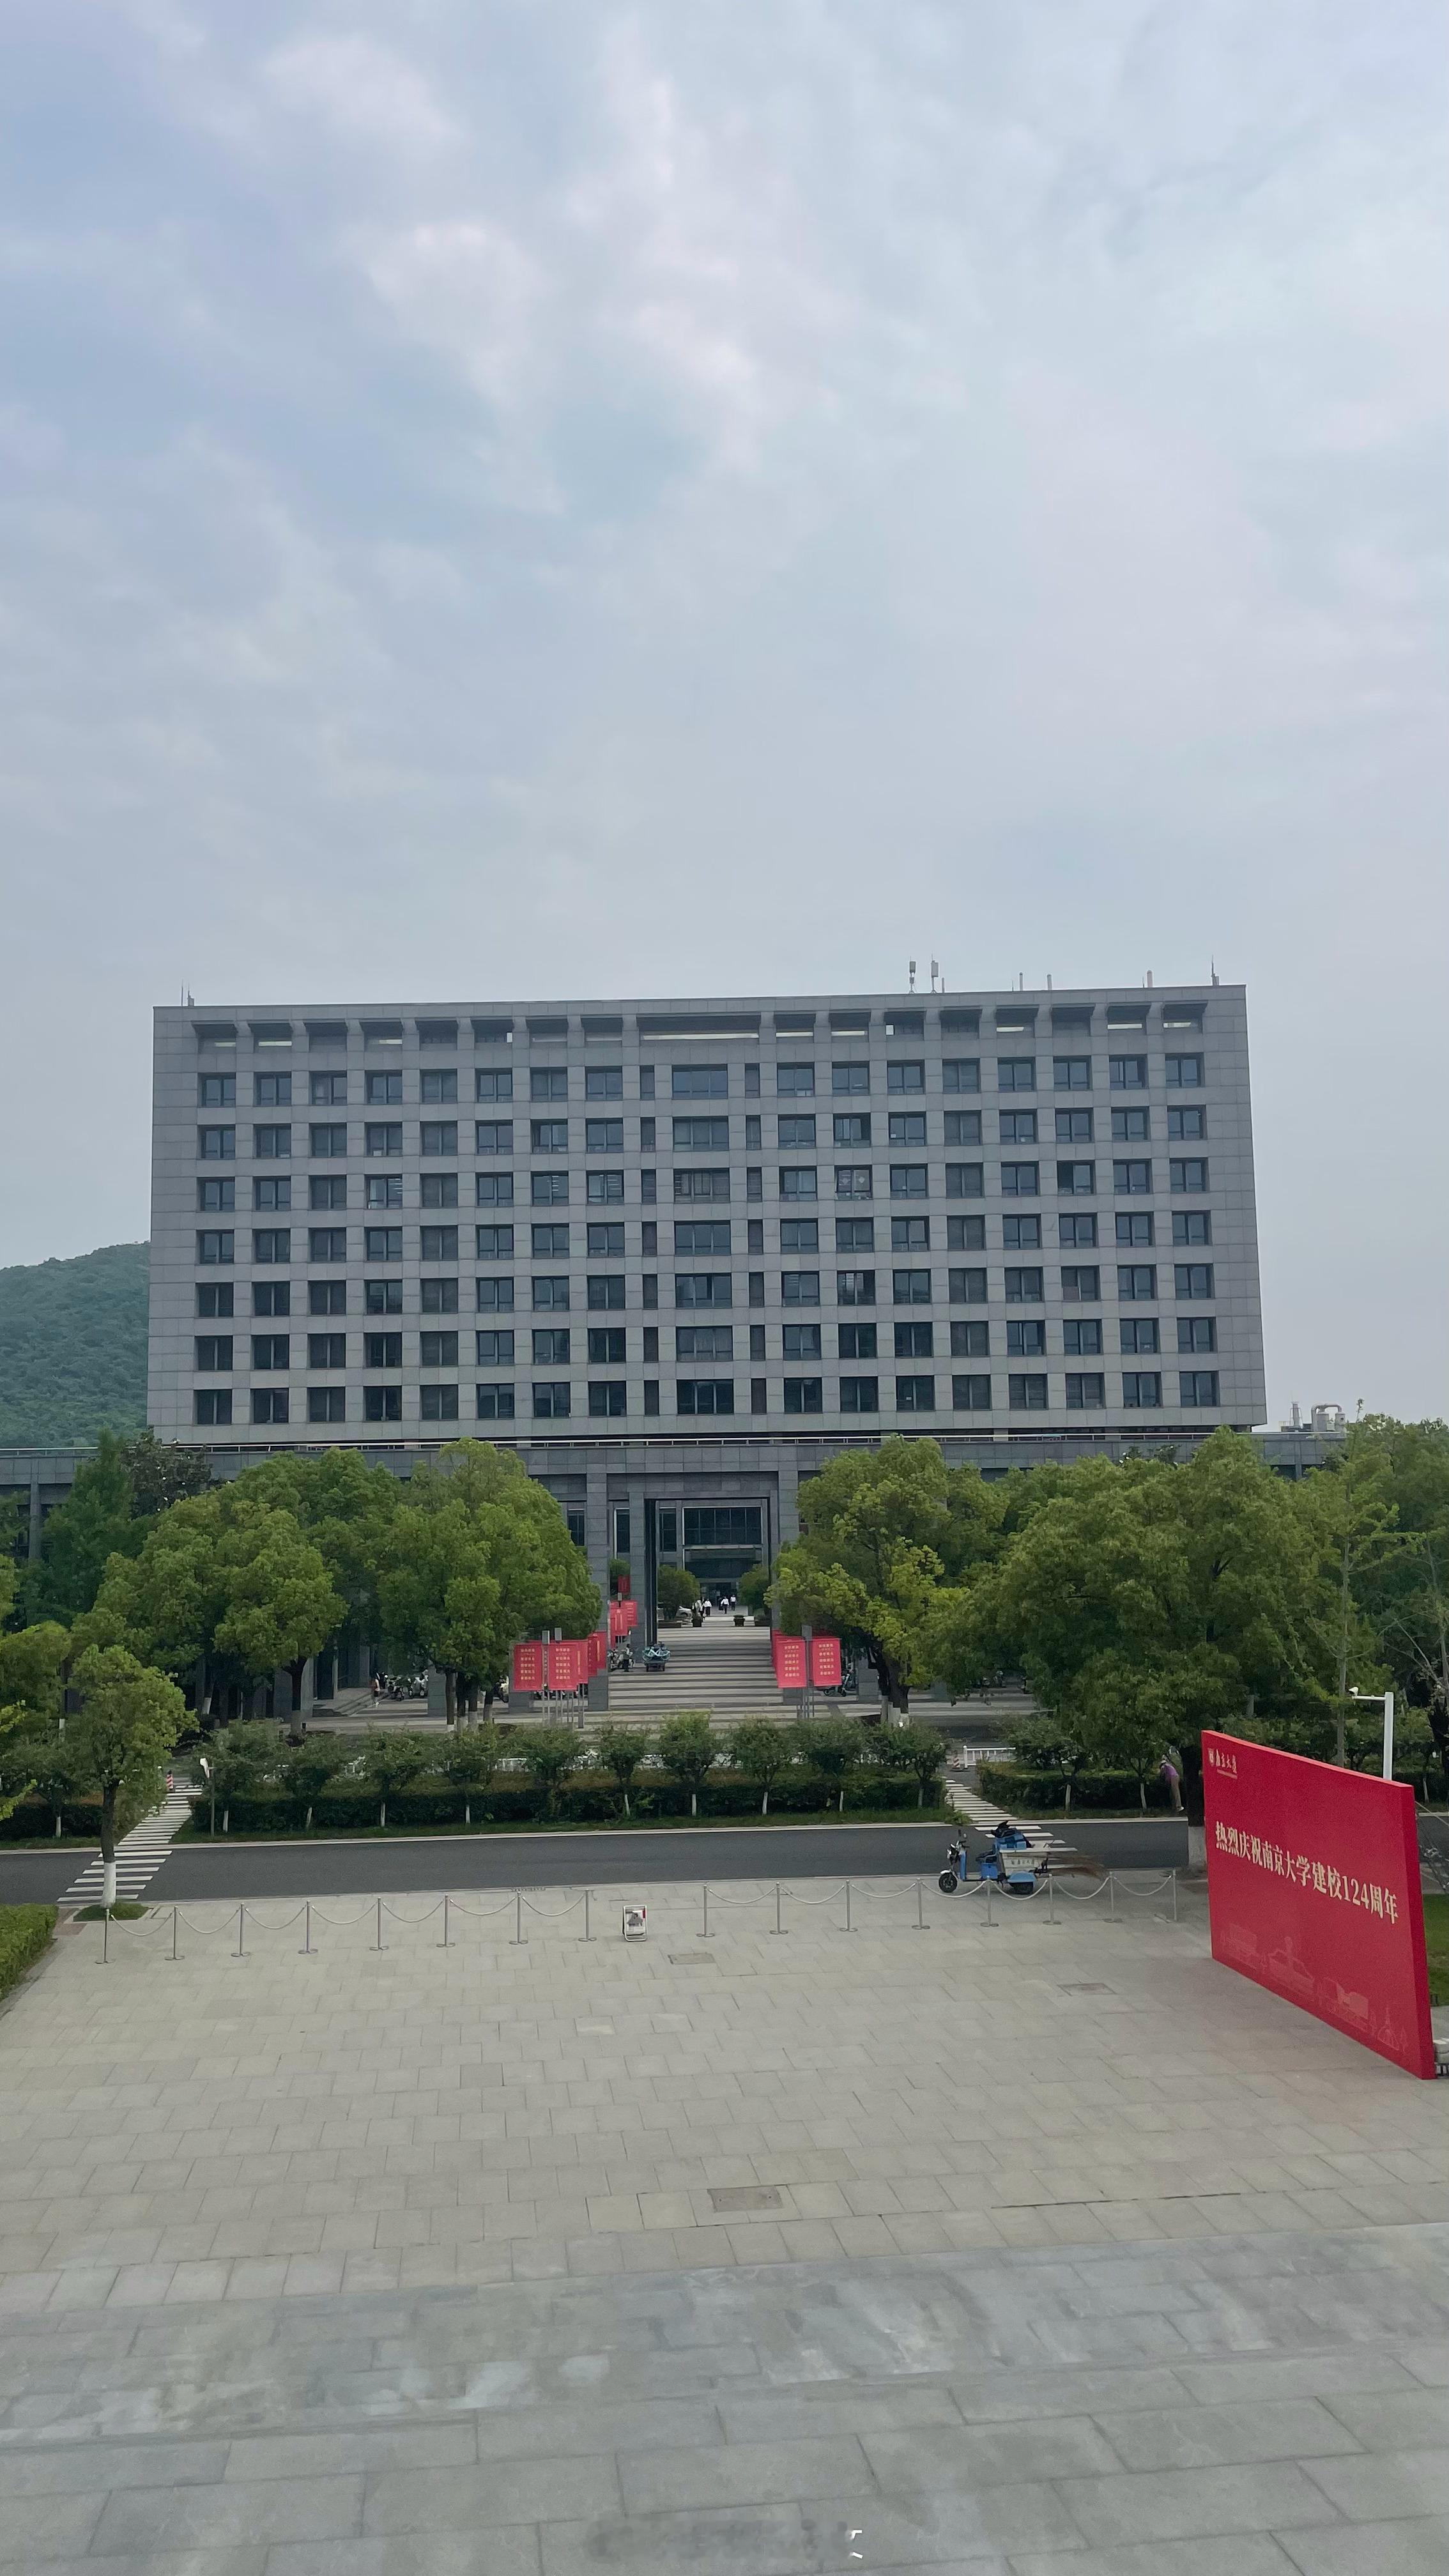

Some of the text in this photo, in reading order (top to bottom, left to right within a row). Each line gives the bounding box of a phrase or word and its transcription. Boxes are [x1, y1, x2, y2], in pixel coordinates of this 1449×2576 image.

[1216, 1821, 1399, 1924] 热烈庆祝南京大学建校124周年
